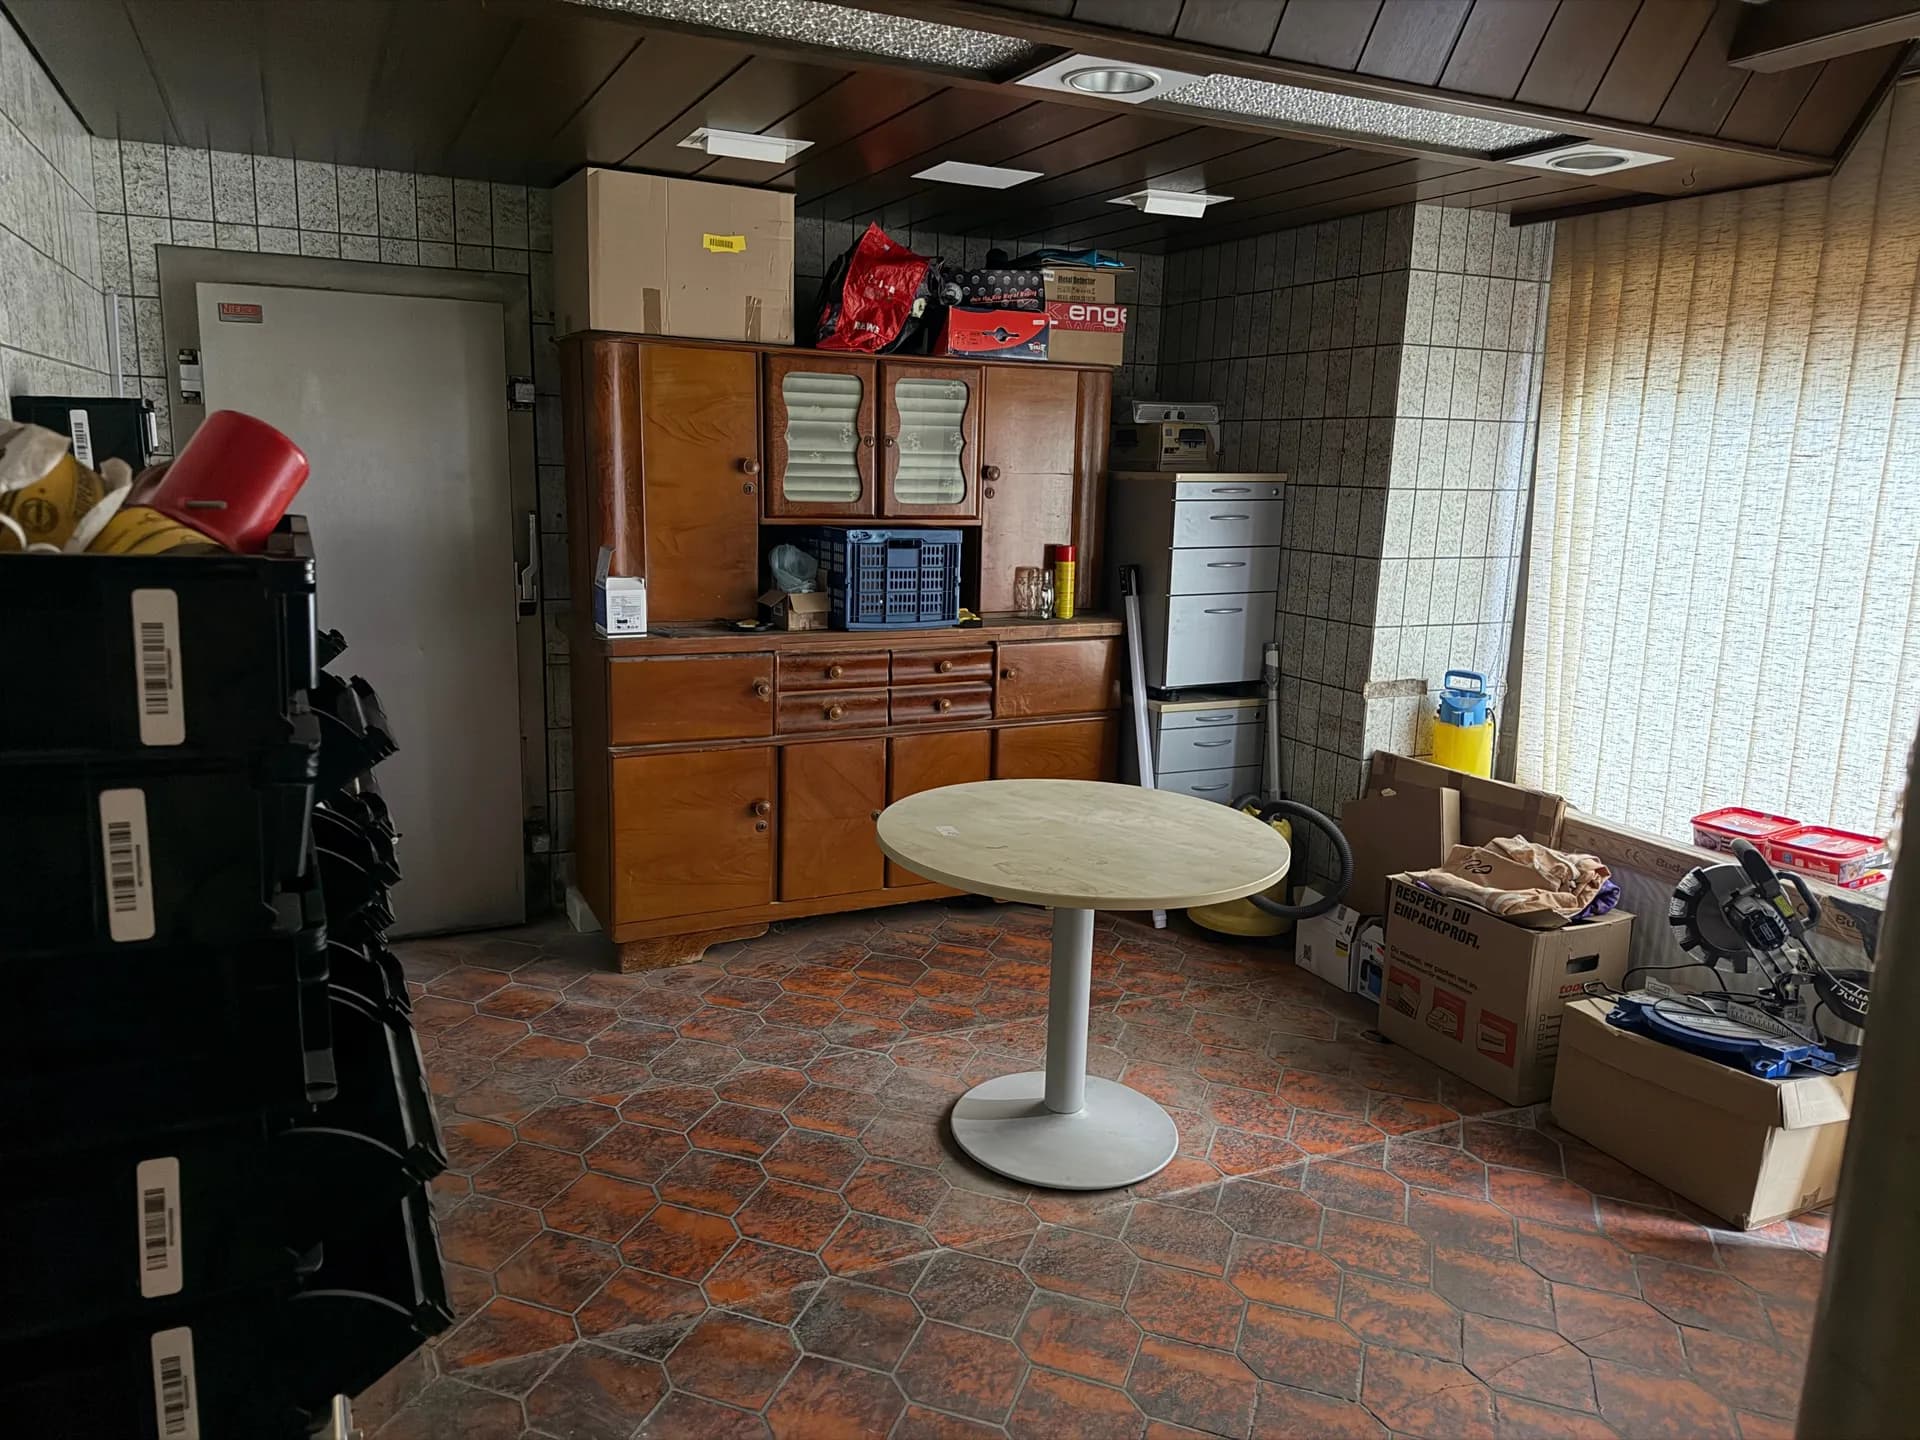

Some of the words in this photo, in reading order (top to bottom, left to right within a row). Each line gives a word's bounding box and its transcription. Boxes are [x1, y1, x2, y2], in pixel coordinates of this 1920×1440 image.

[1393, 901, 1480, 950] EINPACKPROFI.
[1396, 885, 1449, 917] RESPEKT,
[1453, 907, 1471, 926] DU
